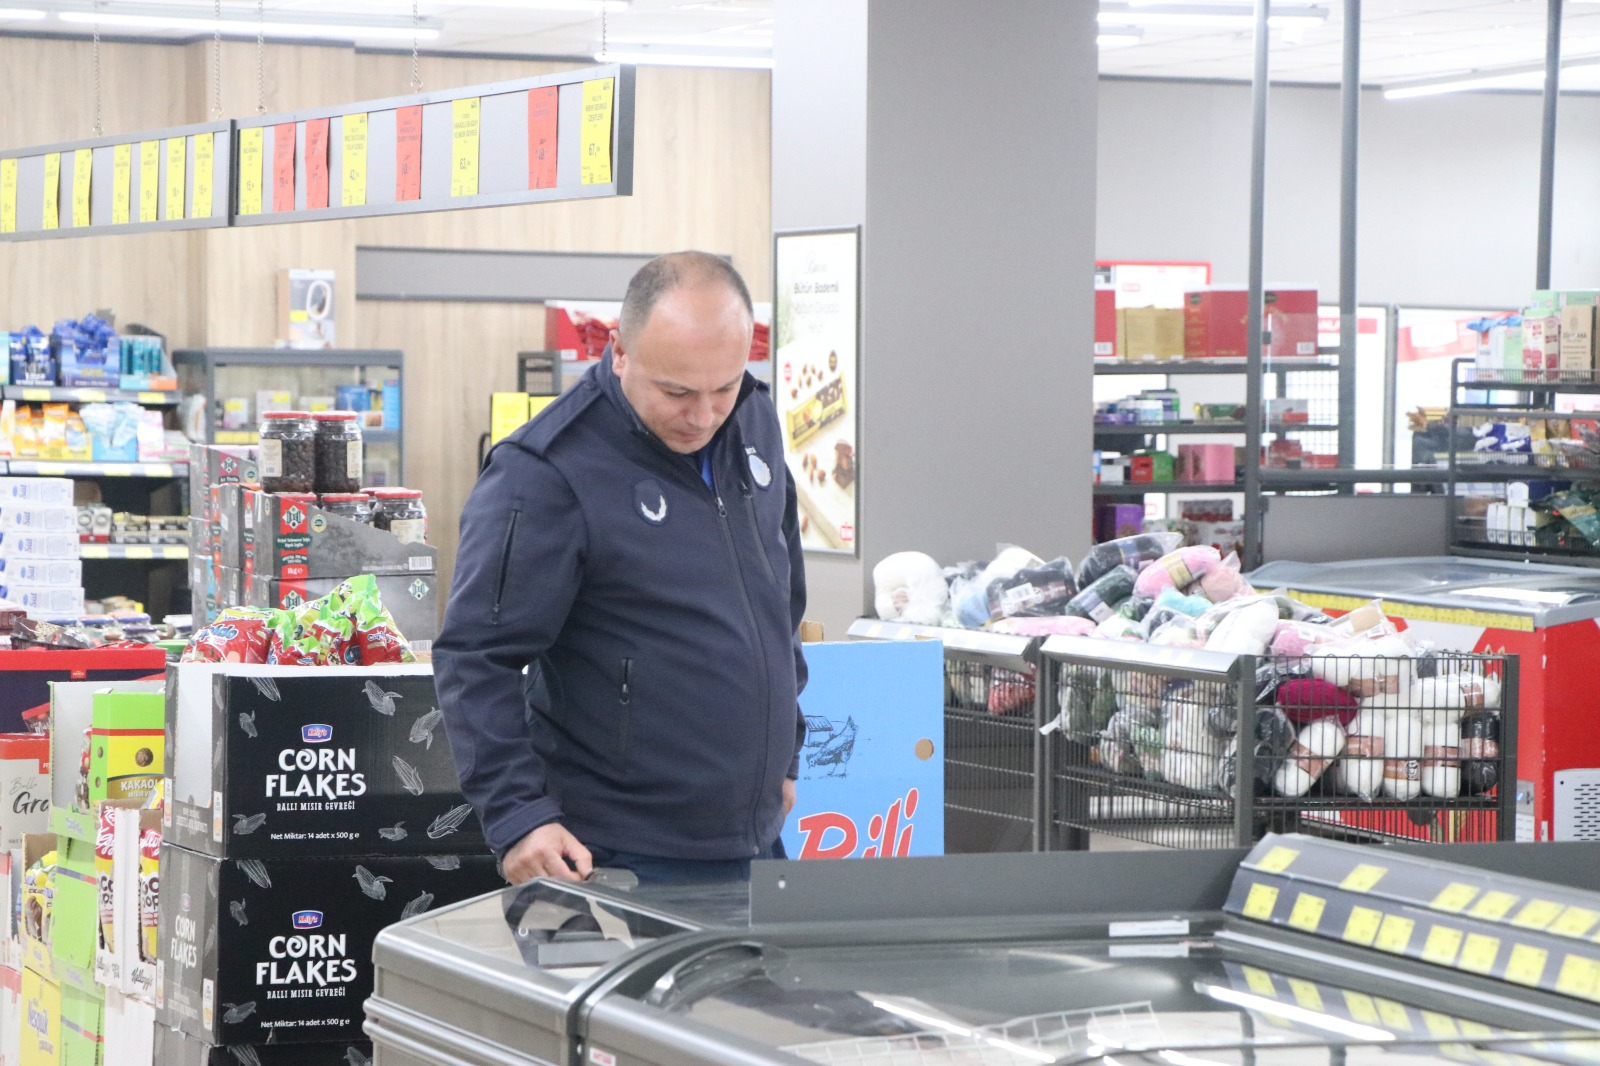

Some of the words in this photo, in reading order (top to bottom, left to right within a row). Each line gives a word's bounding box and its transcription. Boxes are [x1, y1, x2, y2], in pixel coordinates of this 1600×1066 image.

[308, 728, 328, 737] Kelly's
[278, 748, 356, 772] CORN
[265, 773, 367, 800] FLAKES
[277, 802, 297, 812] BALLI
[300, 802, 322, 811] MISIR
[325, 800, 355, 810] GEVREĞİ
[175, 914, 196, 943] CORN
[298, 915, 318, 925] Kelly's
[171, 938, 197, 969] FLAKES
[269, 934, 346, 958] CORN
[256, 959, 357, 987] FLAKES
[267, 990, 288, 999] BALLI
[291, 989, 313, 998] MISIR
[315, 986, 346, 997] GEVREĞİ
[274, 1020, 297, 1028] Miktar:
